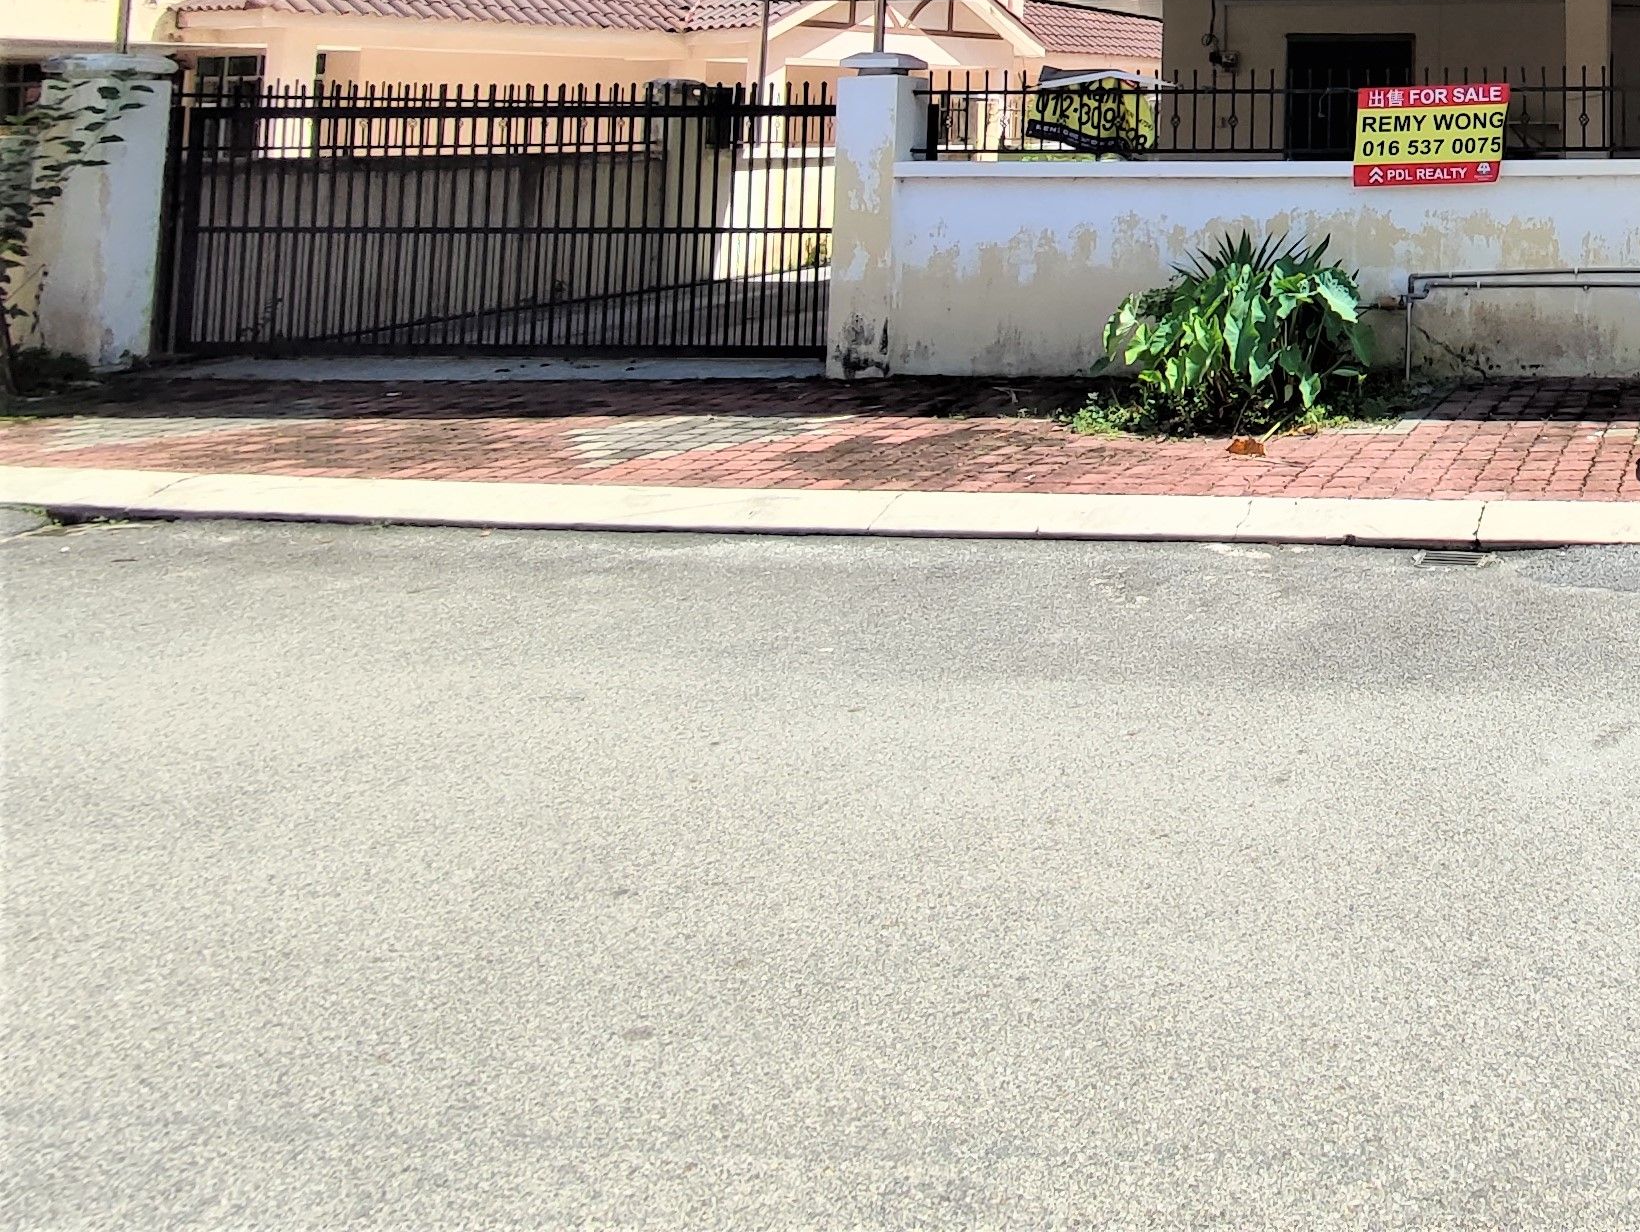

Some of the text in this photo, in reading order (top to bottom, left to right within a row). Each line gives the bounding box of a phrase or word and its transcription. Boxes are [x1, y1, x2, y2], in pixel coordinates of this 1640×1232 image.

[1368, 89, 1404, 108] 出售
[1409, 86, 1502, 105] FOR SALE
[1362, 111, 1504, 133] REMY WONG
[1362, 137, 1501, 157] 016 537 0075
[1386, 168, 1413, 181] PDL
[1416, 167, 1468, 180] REALTY
